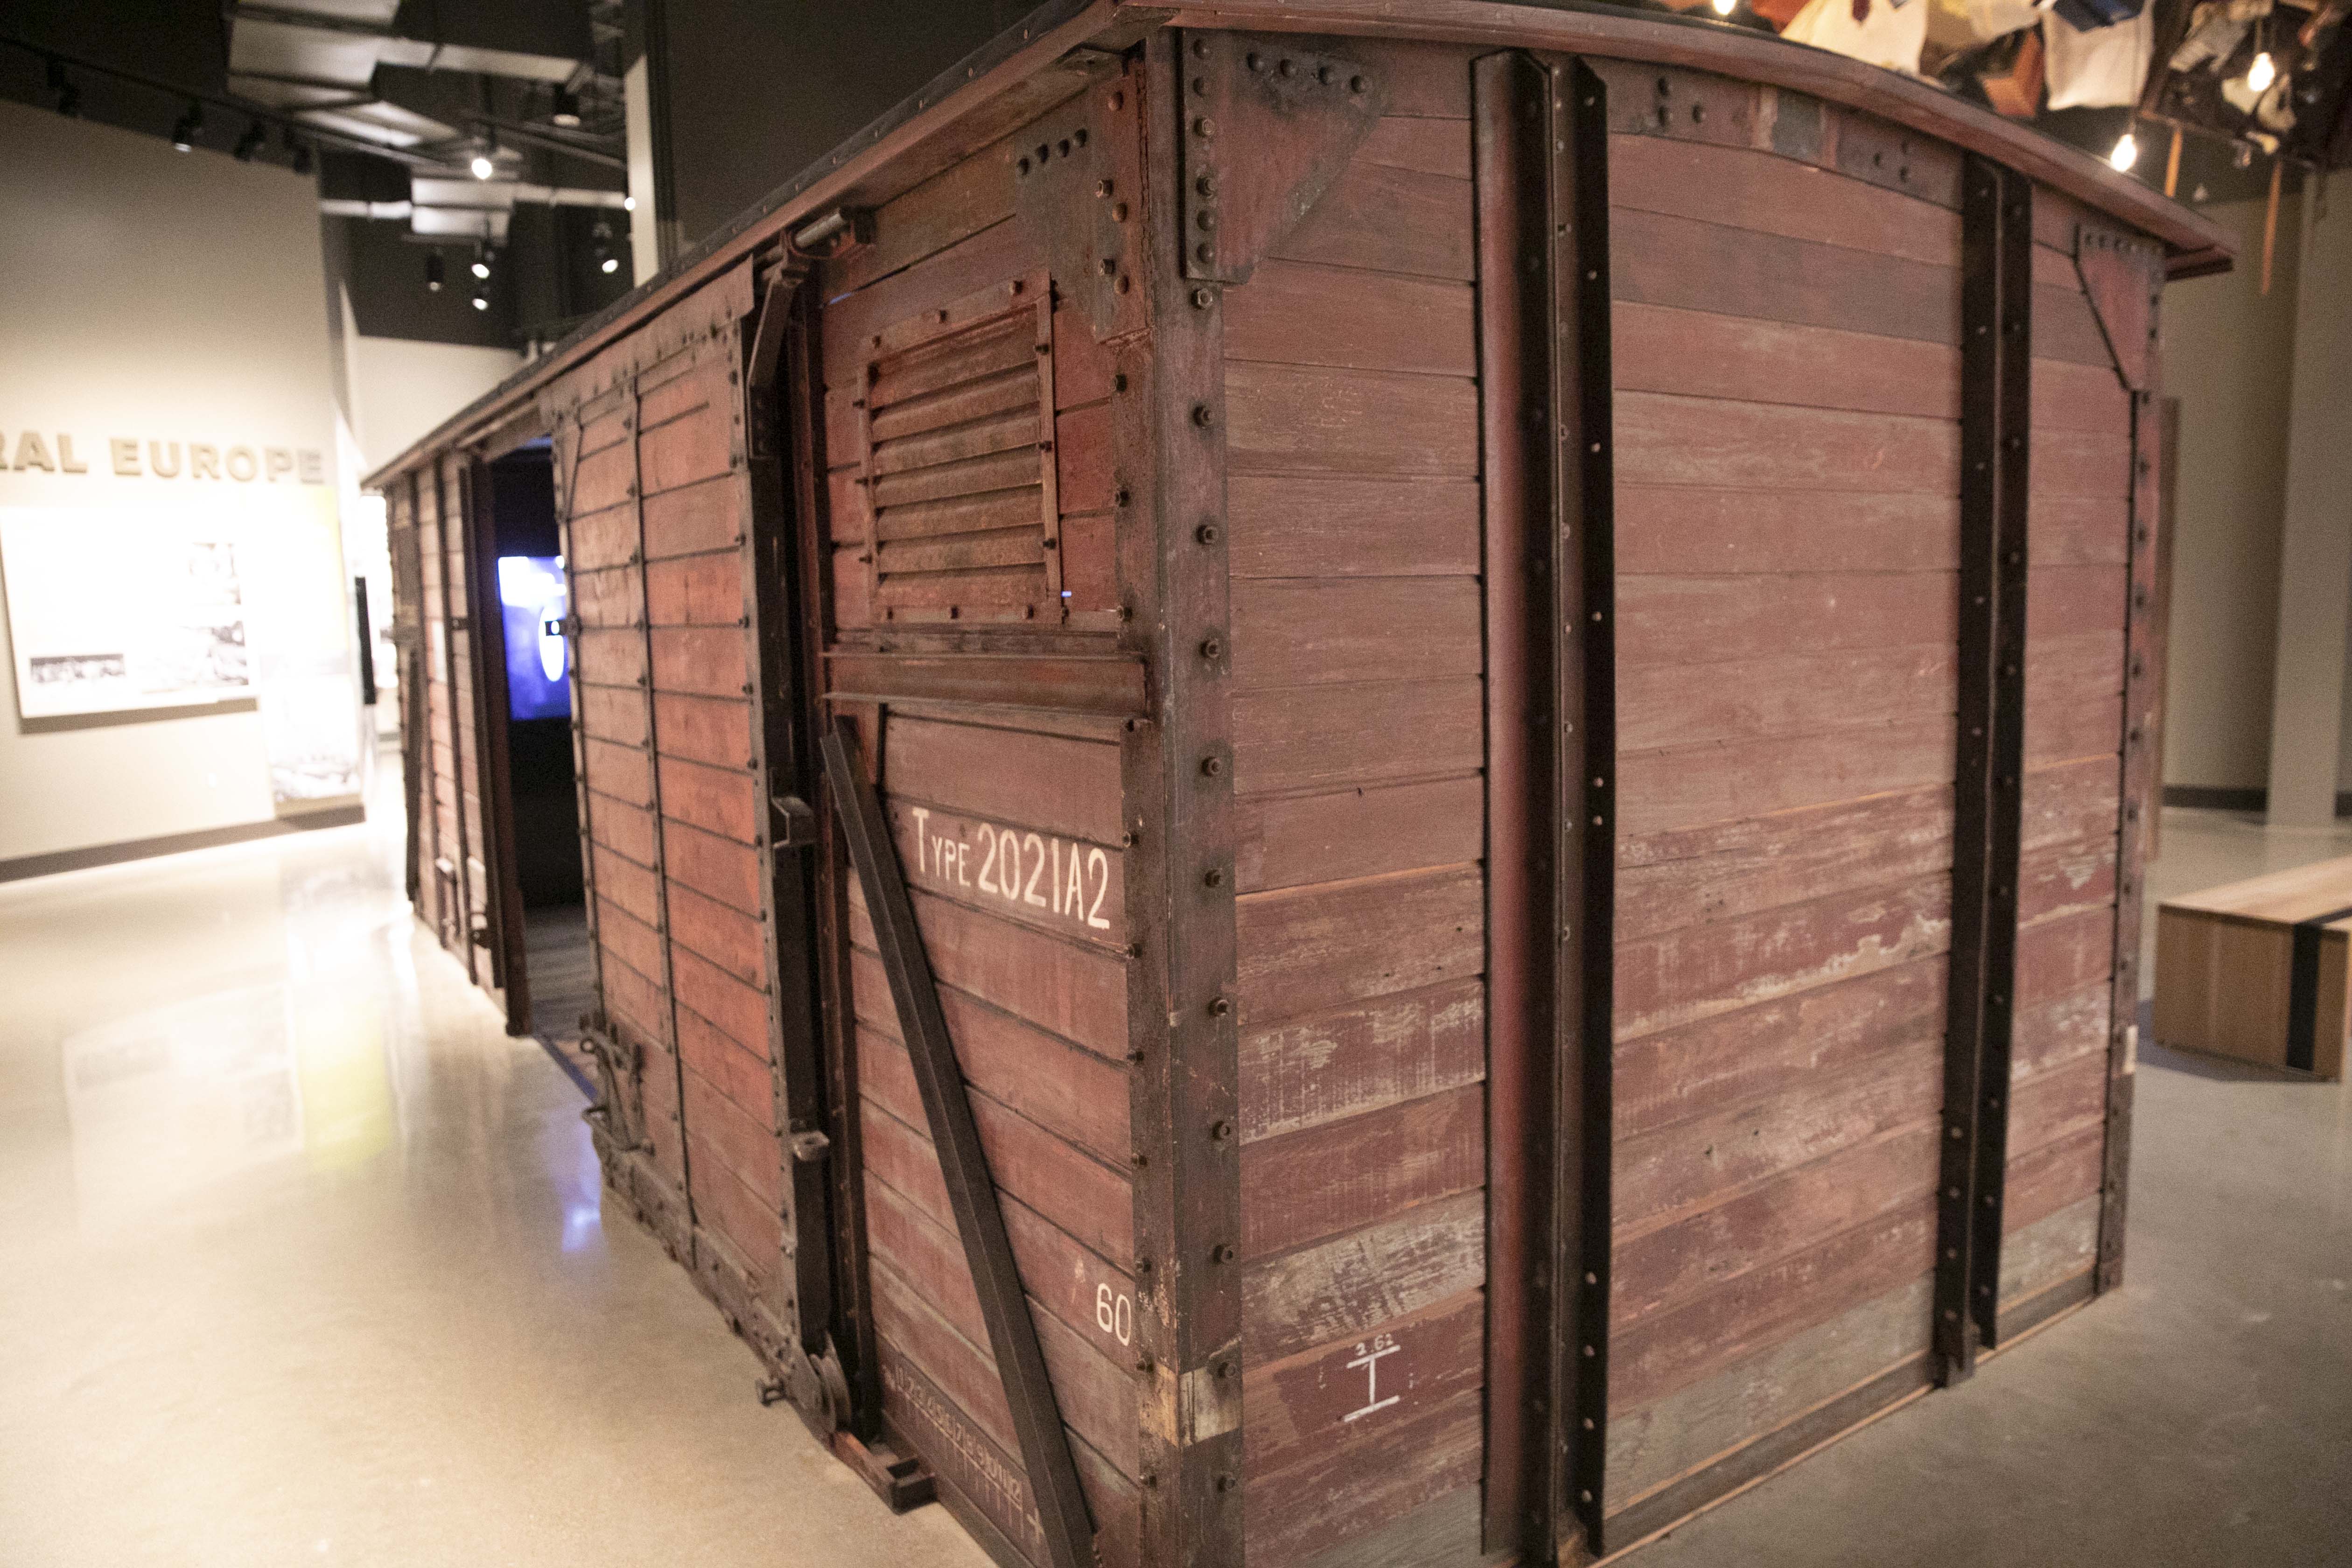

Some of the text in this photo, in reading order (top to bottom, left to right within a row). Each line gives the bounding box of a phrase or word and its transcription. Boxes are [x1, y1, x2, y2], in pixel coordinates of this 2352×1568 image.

[0, 429, 325, 484] AL EUROPE
[978, 823, 1110, 929] 2021A2
[1097, 1283, 1132, 1346] 60
